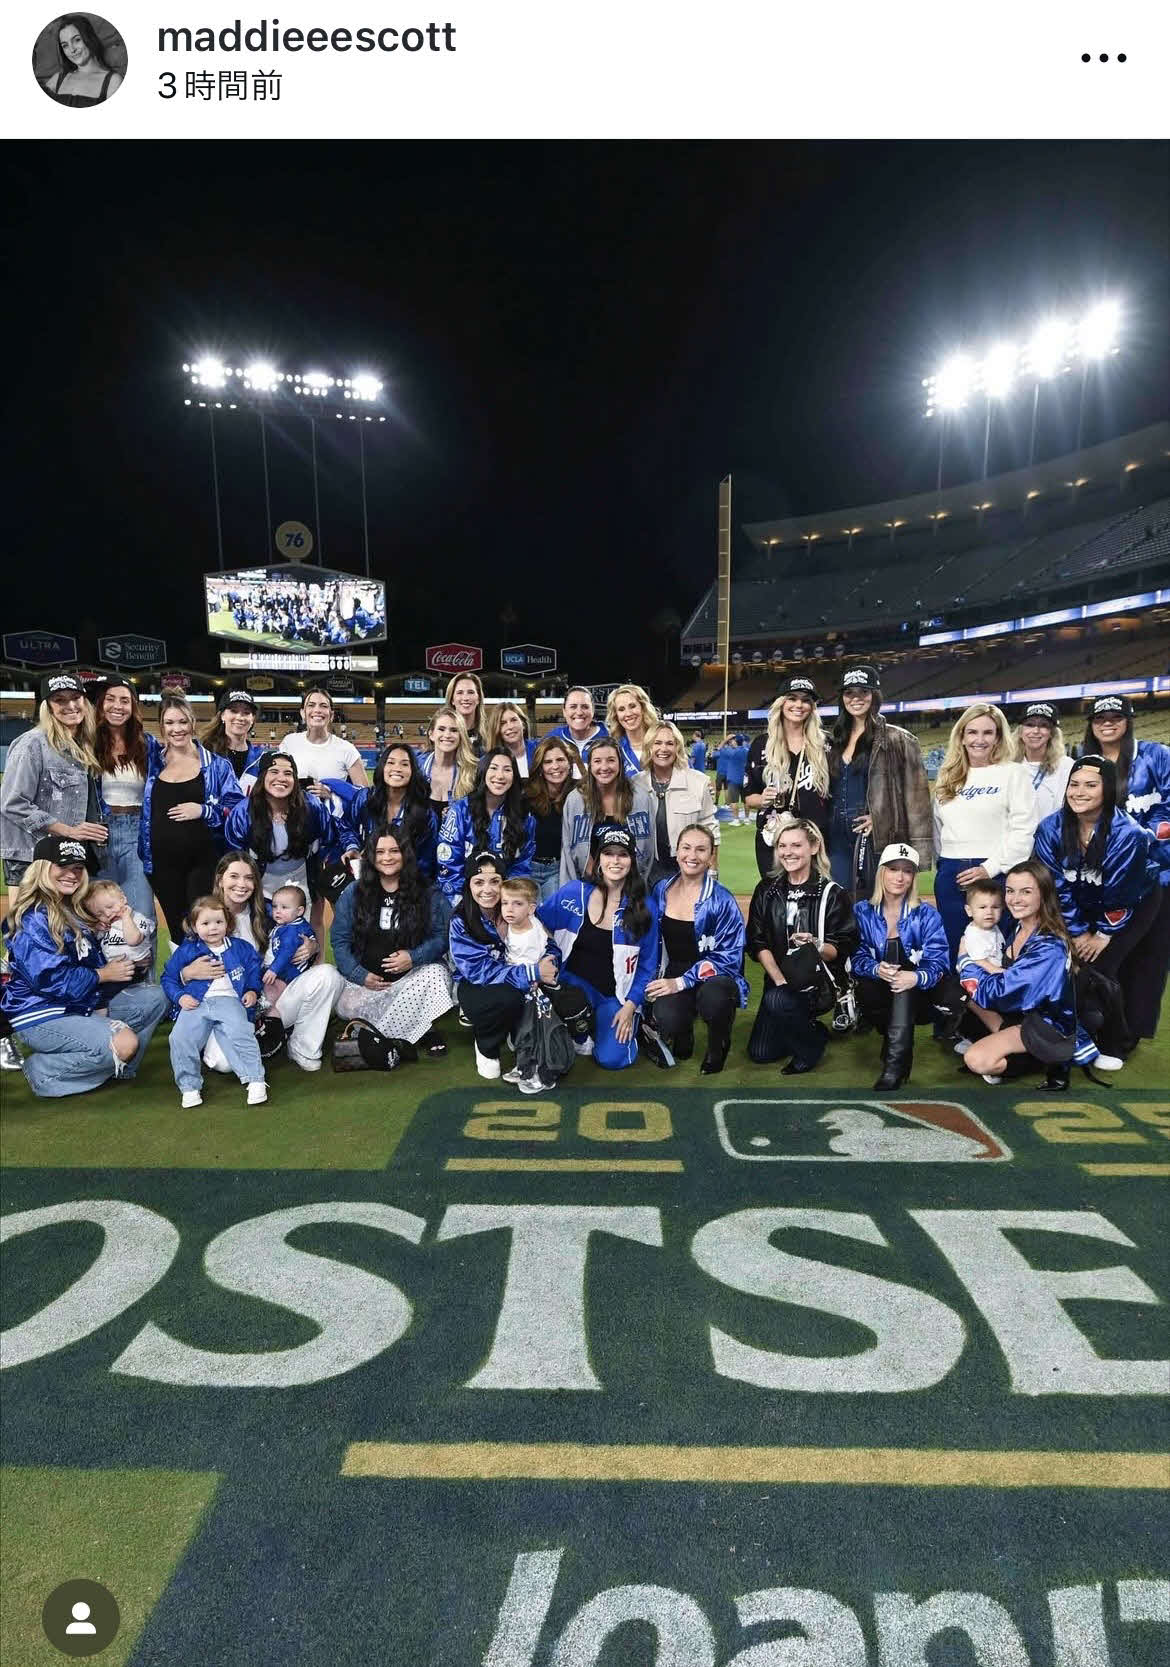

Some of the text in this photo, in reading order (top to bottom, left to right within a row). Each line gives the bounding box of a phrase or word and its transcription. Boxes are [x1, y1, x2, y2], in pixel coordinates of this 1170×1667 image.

[285, 533, 304, 548] 76
[20, 640, 60, 650] ULTRA
[125, 643, 160, 654] Security
[505, 655, 551, 664] UCLA Health
[408, 680, 427, 690] TEL
[956, 785, 999, 801] odgers
[899, 844, 909, 857] LA
[464, 1101, 673, 1143] 20
